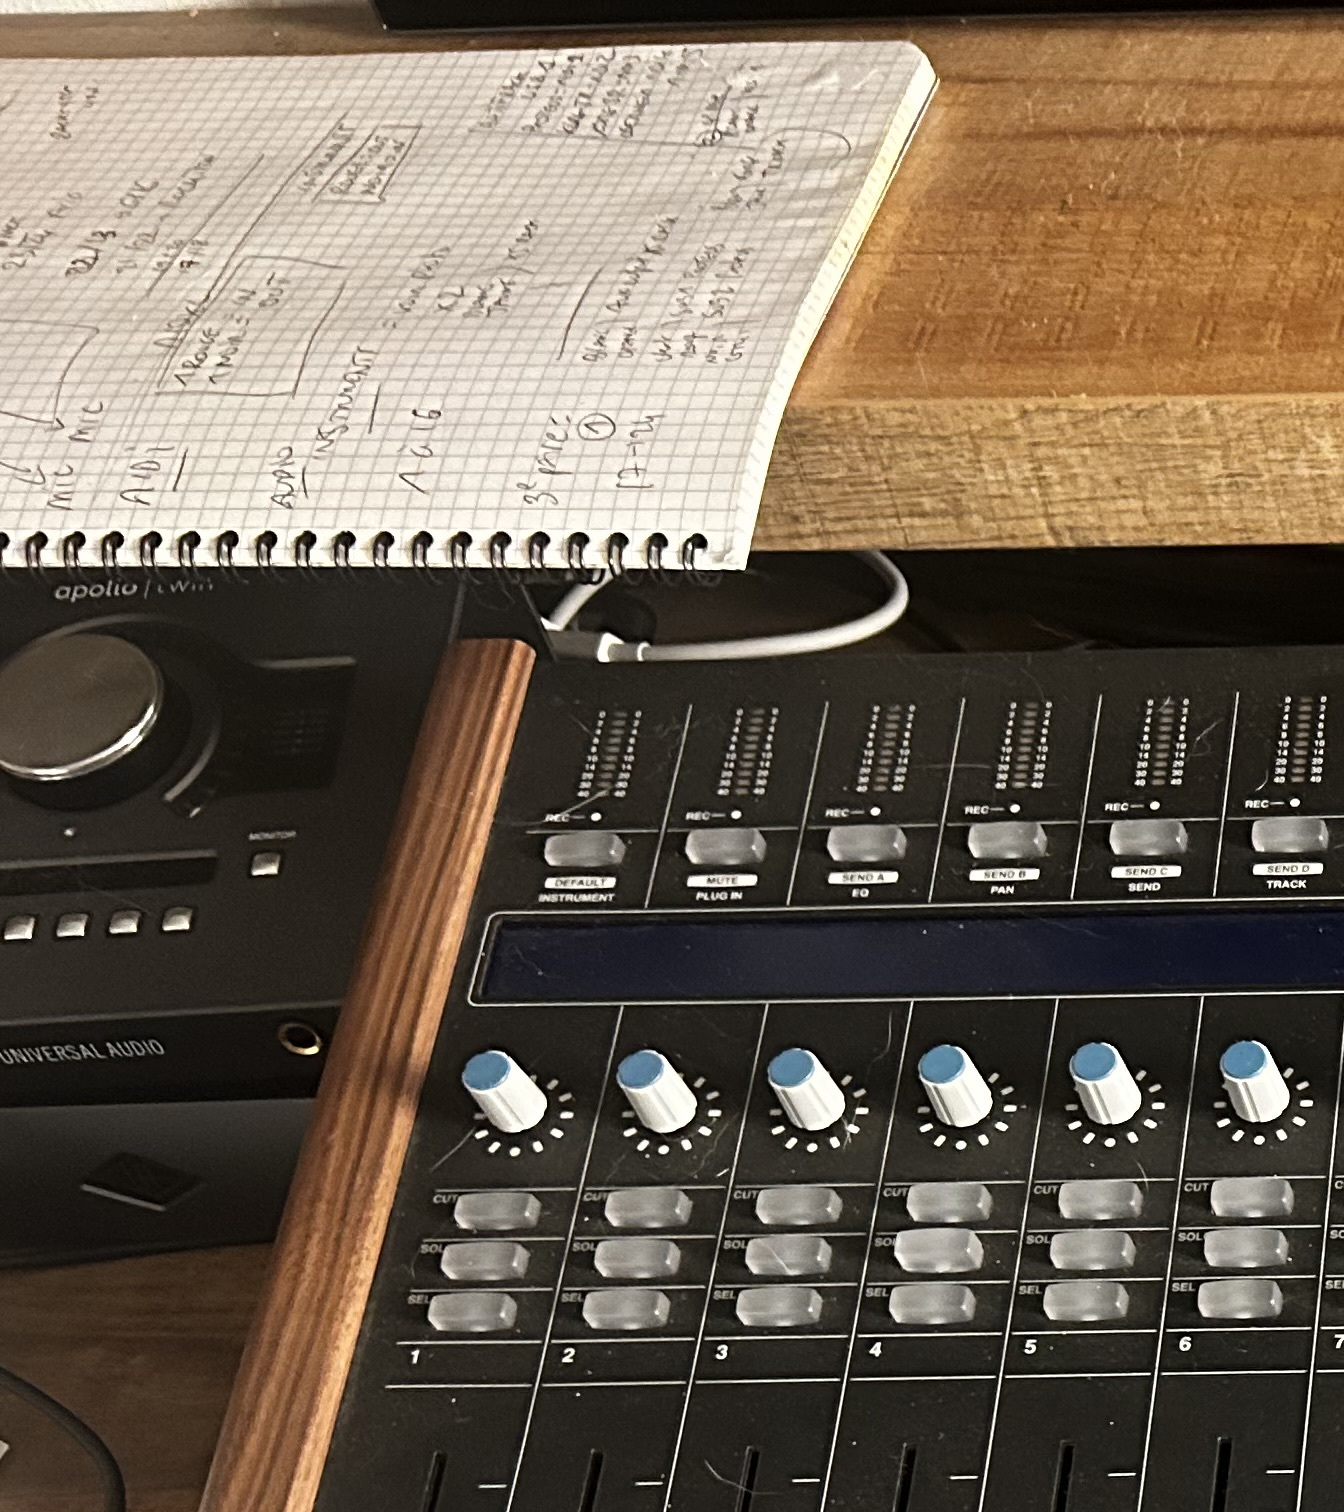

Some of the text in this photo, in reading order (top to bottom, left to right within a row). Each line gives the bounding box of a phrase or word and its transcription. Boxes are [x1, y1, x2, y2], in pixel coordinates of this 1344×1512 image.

[1104, 802, 1128, 812] REC
[1245, 799, 1269, 809] REC
[826, 808, 849, 817] REC
[965, 806, 988, 814] REC
[686, 812, 710, 820] REC
[1128, 882, 1161, 891] SEND
[1266, 879, 1307, 889] TRACK
[538, 893, 614, 903] INSTRUMENT
[0, 1039, 165, 1065] UNIVERSAL AUDIO
[1034, 1185, 1058, 1195] CUT
[1184, 1183, 1209, 1192] CUT
[866, 1287, 889, 1297] SEL
[1018, 1285, 1042, 1295] SEL
[1172, 1282, 1195, 1292] SEL
[1024, 1340, 1037, 1354] 5
[1179, 1337, 1192, 1351] 6
[715, 1346, 729, 1360] 3
[869, 1342, 882, 1357] 4
[411, 1350, 420, 1363] 1
[562, 1348, 576, 1363] 2
